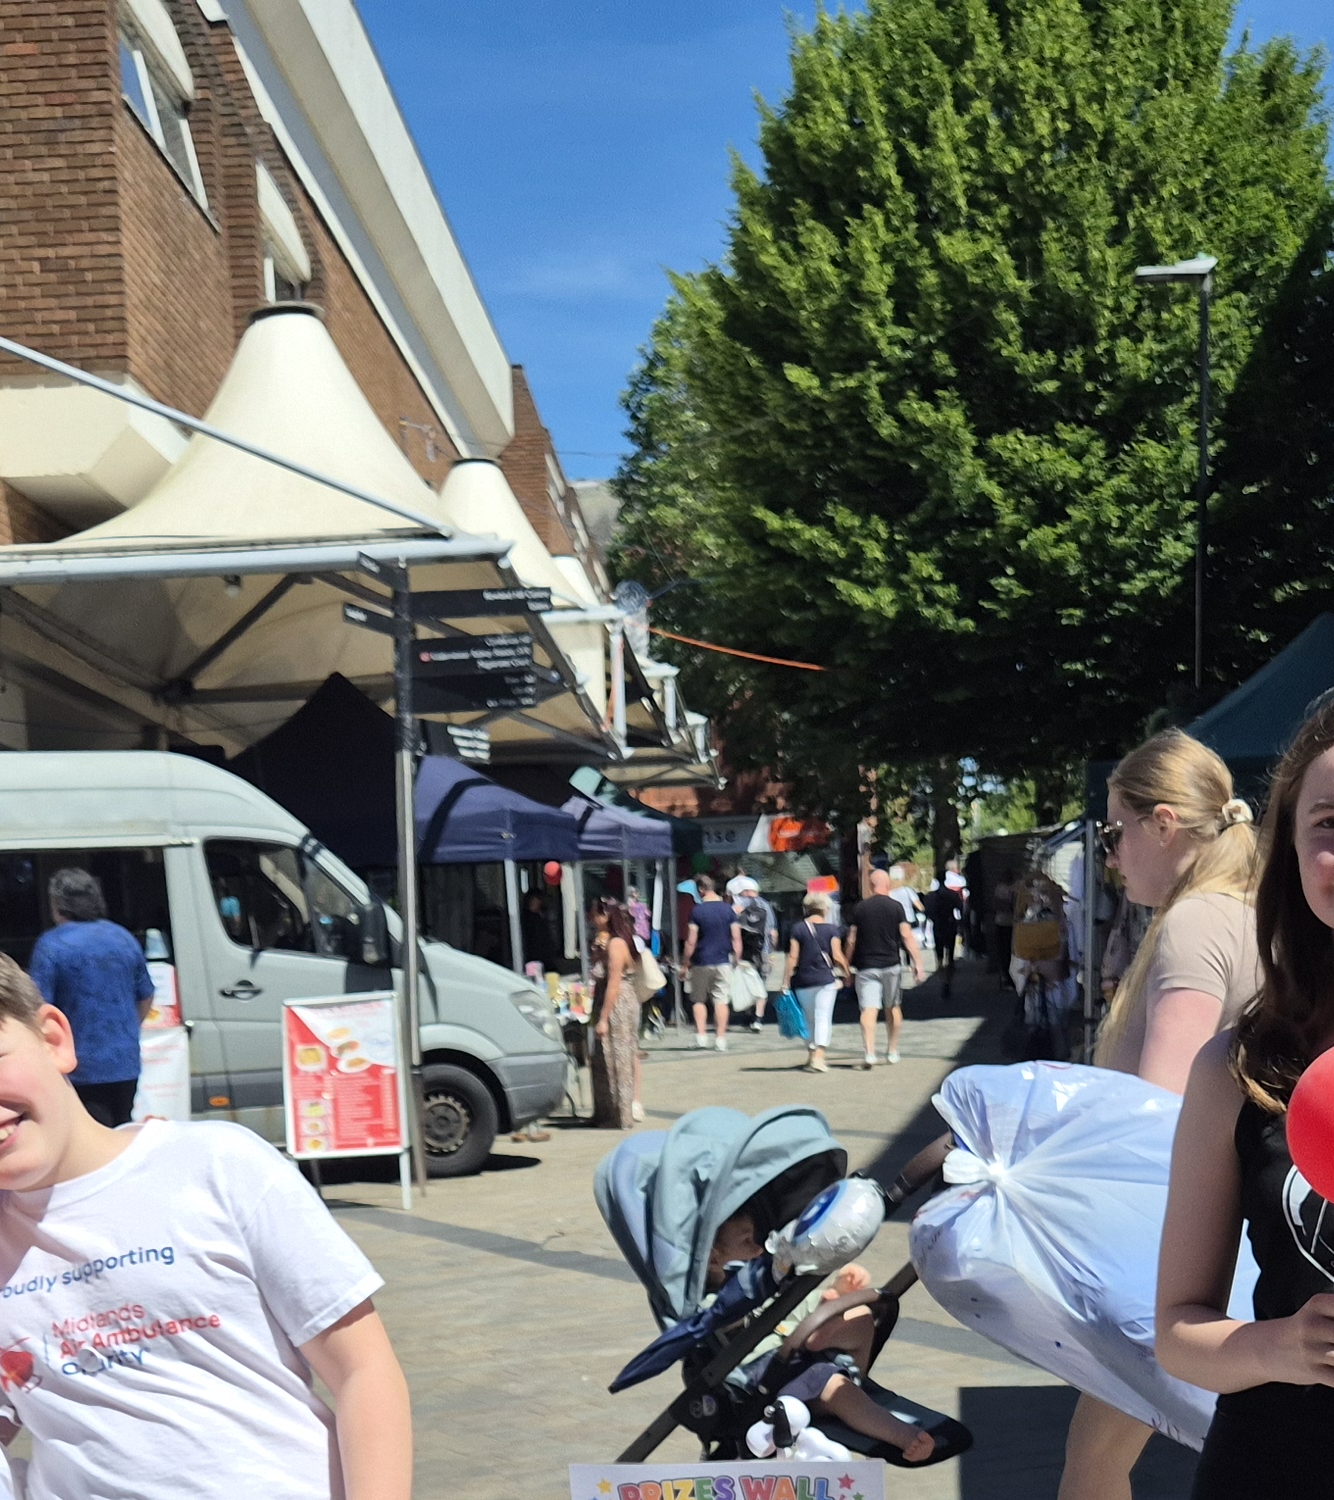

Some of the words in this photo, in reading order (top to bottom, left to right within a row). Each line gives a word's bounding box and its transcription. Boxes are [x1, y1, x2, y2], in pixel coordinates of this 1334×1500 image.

[61, 1246, 175, 1285] supporting
[51, 1303, 146, 1339] Midlands
[92, 1312, 221, 1349] Ambulance
